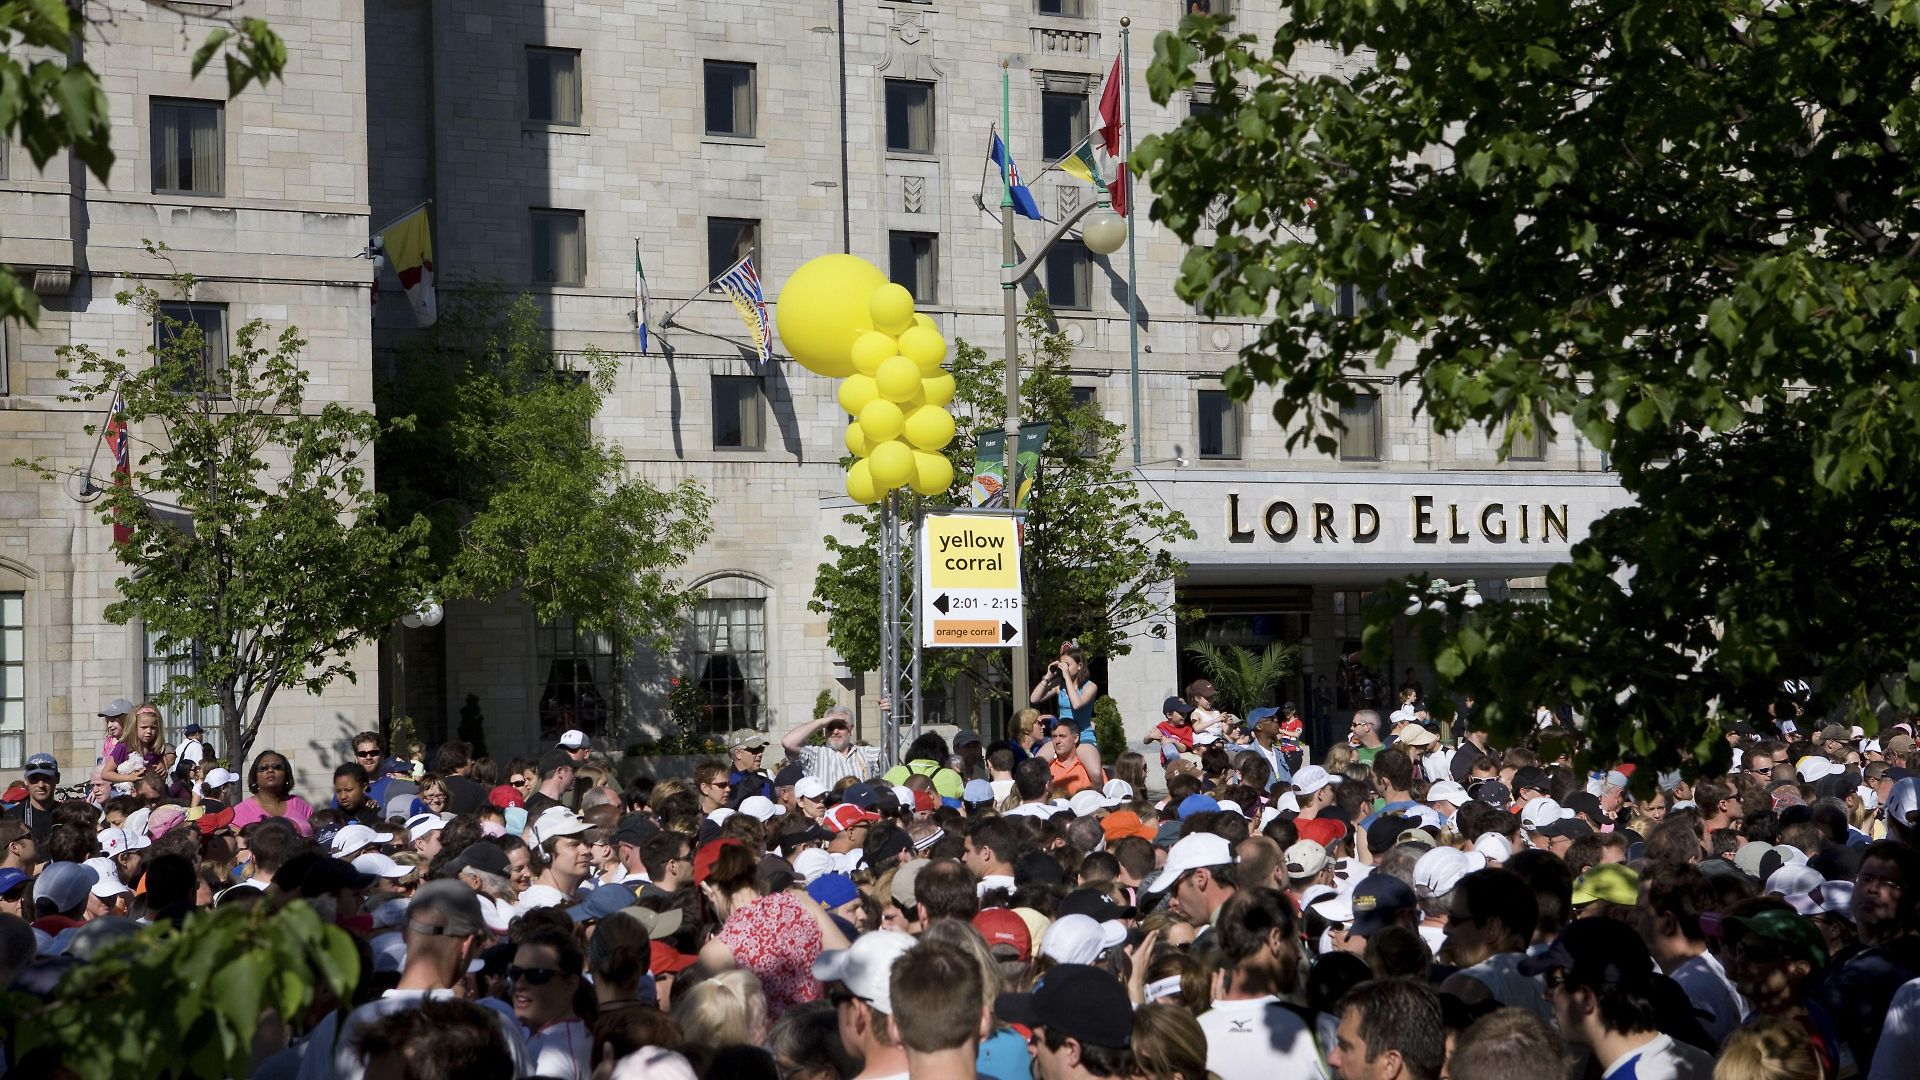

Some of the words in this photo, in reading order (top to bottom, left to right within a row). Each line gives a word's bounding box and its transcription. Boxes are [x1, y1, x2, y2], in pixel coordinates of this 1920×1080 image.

[1226, 493, 1380, 543] LORD
[1411, 495, 1568, 543] ELGIN
[939, 530, 1005, 552] yellow
[945, 553, 1002, 571] corral
[952, 597, 978, 609] 2:01
[991, 597, 1018, 609] 2:15
[936, 627, 968, 637] orange
[970, 626, 996, 636] corral
